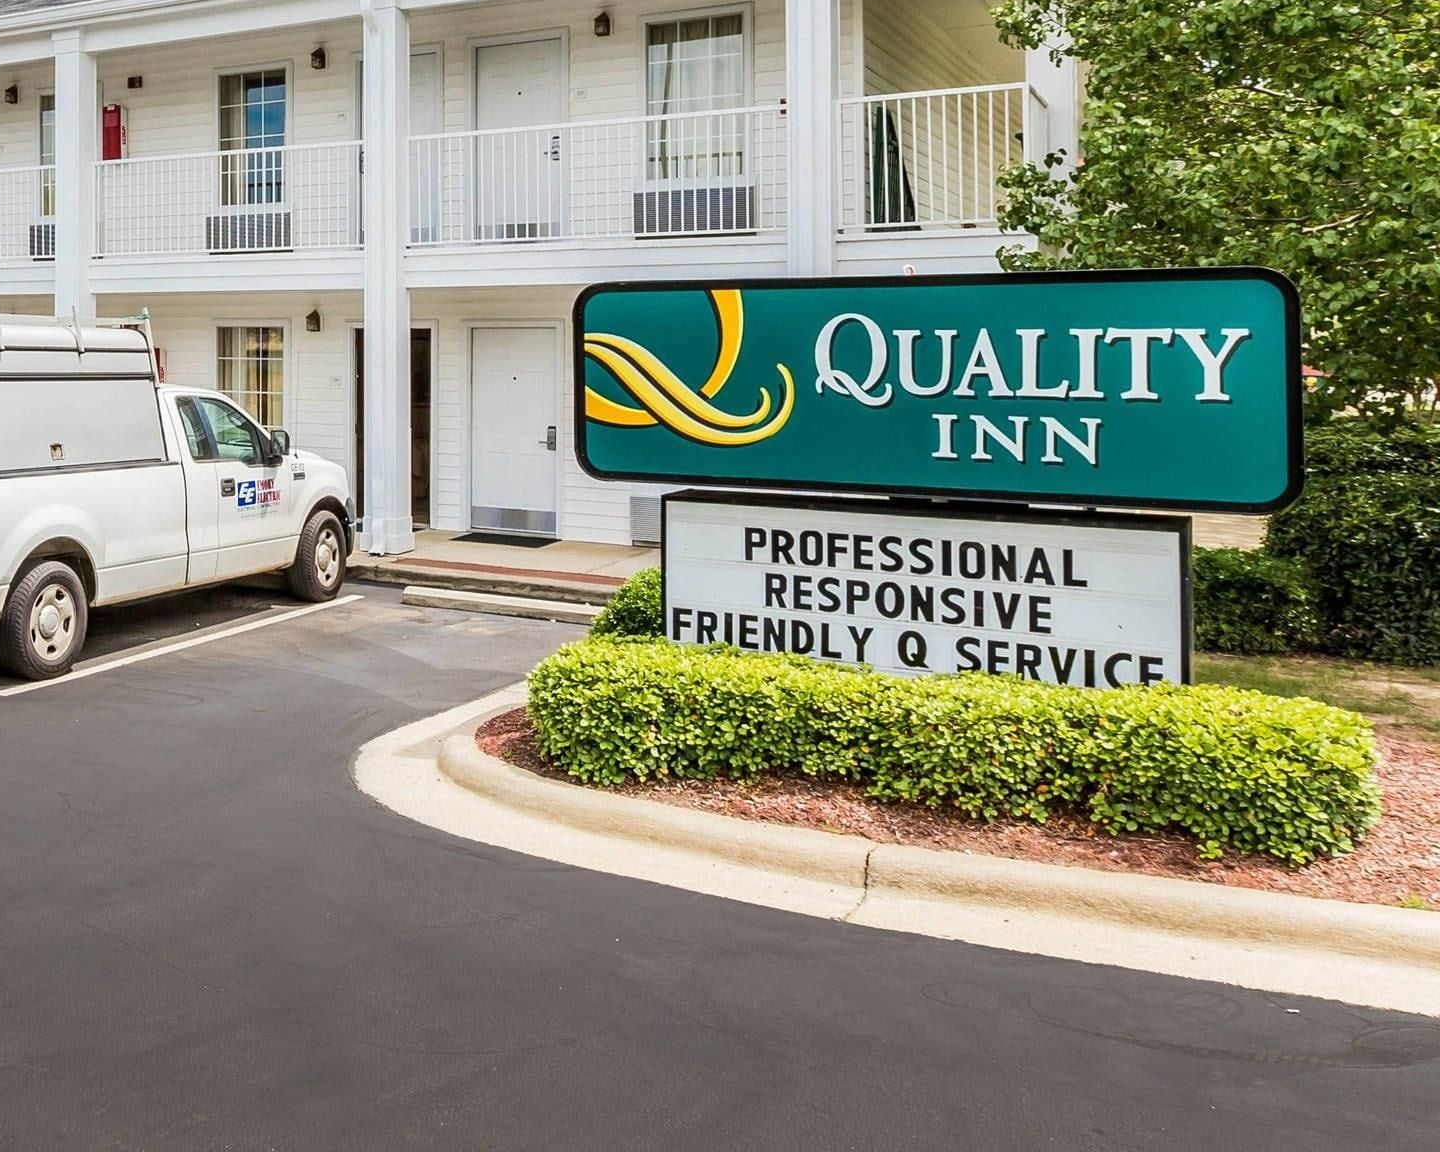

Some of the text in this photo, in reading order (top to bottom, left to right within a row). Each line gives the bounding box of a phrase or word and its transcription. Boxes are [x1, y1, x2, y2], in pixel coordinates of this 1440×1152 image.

[814, 313, 1250, 407] QUALITY
[932, 414, 1102, 465] INN
[744, 527, 1088, 588] PROFESSIONAL
[764, 573, 1052, 634] RESPONSIVE
[672, 606, 1163, 688] FRIENDLY Q SERVICE
